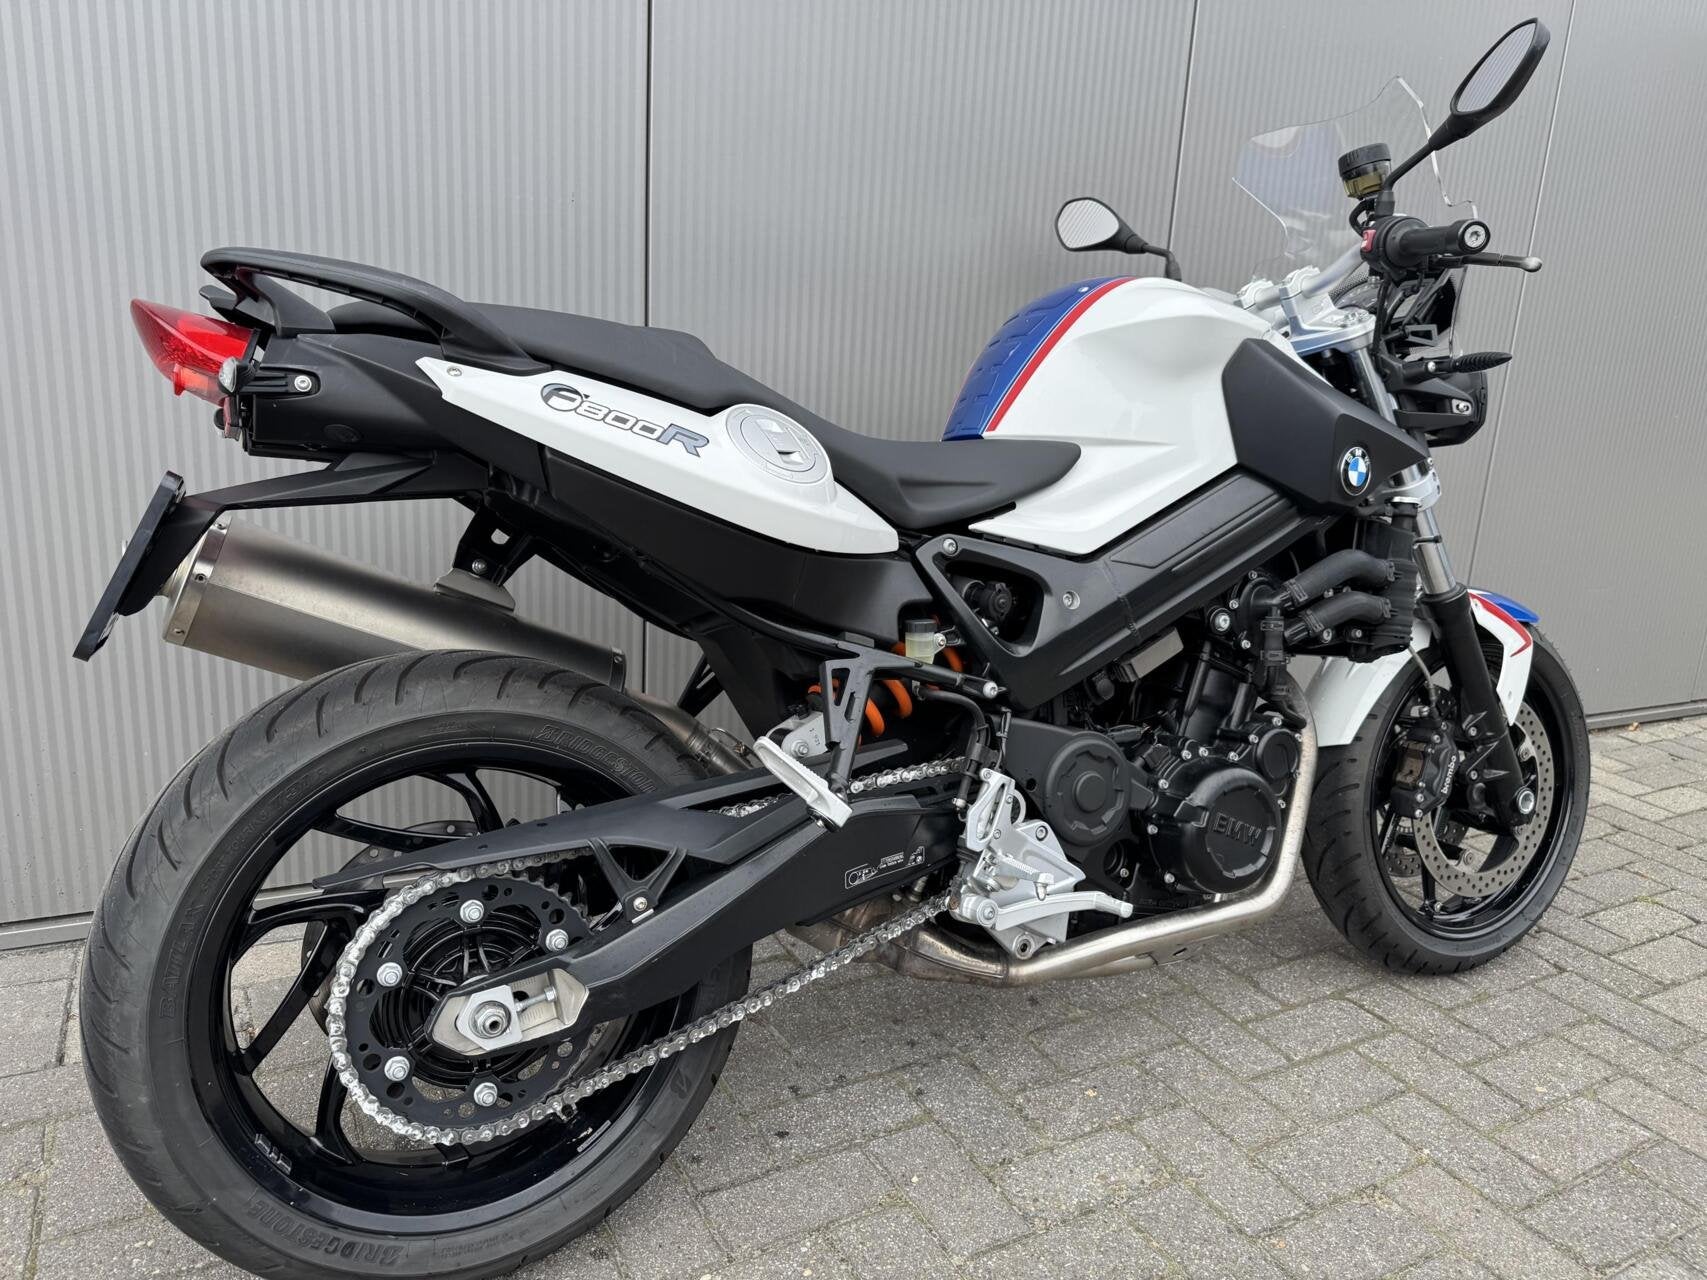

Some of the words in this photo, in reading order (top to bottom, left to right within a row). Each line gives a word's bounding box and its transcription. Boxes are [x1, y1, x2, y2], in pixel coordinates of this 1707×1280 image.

[535, 724, 657, 793] BRIDGESTON
[1441, 754, 1457, 795] brembo
[1212, 811, 1263, 847] BMW
[248, 1200, 405, 1267] BRIDGESTONE
